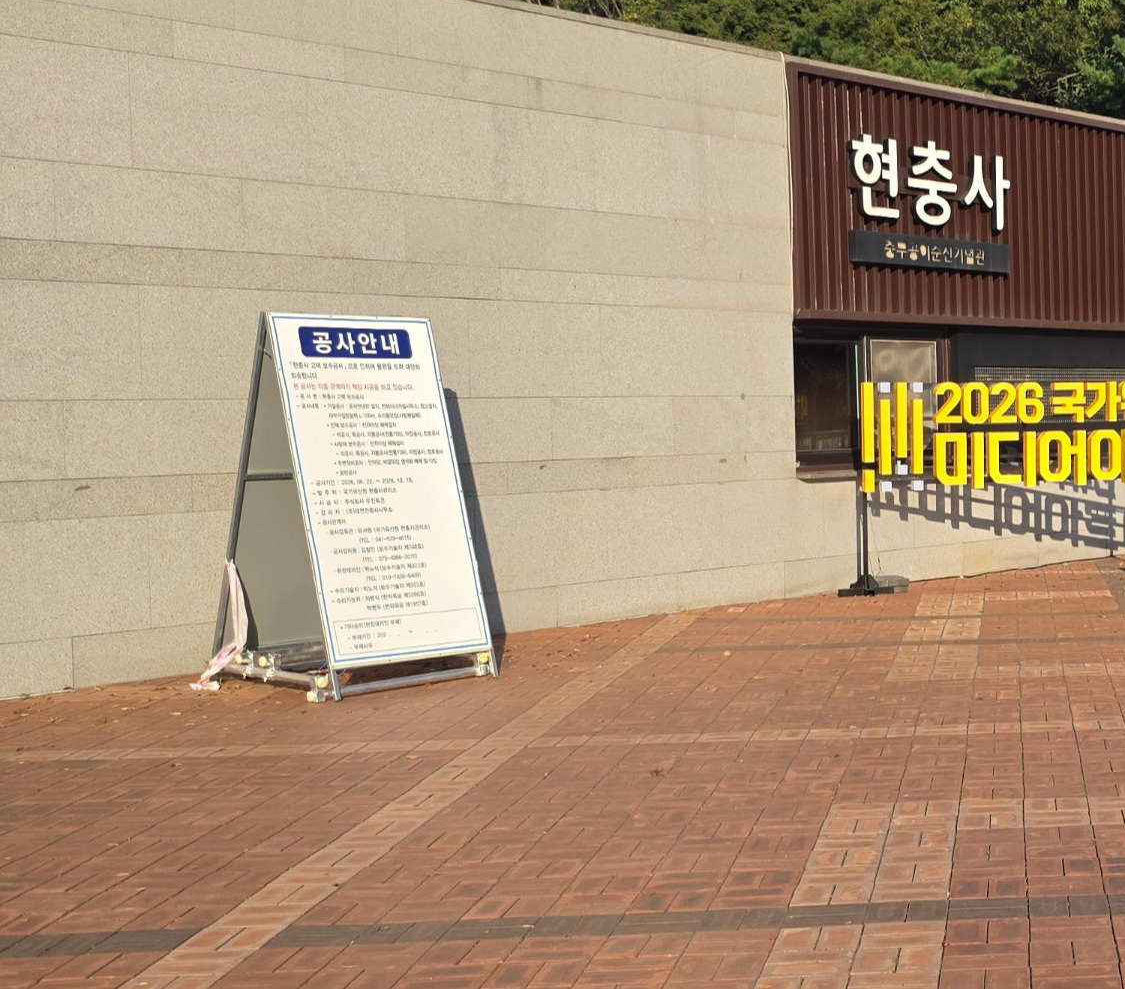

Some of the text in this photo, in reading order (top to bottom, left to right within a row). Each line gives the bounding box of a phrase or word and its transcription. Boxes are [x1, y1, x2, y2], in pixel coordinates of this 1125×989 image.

[850, 133, 1011, 231] 현충사
[884, 240, 985, 266] 충무공이순신기념관
[312, 331, 400, 355] 공사안내
[933, 381, 1045, 425] 2026
